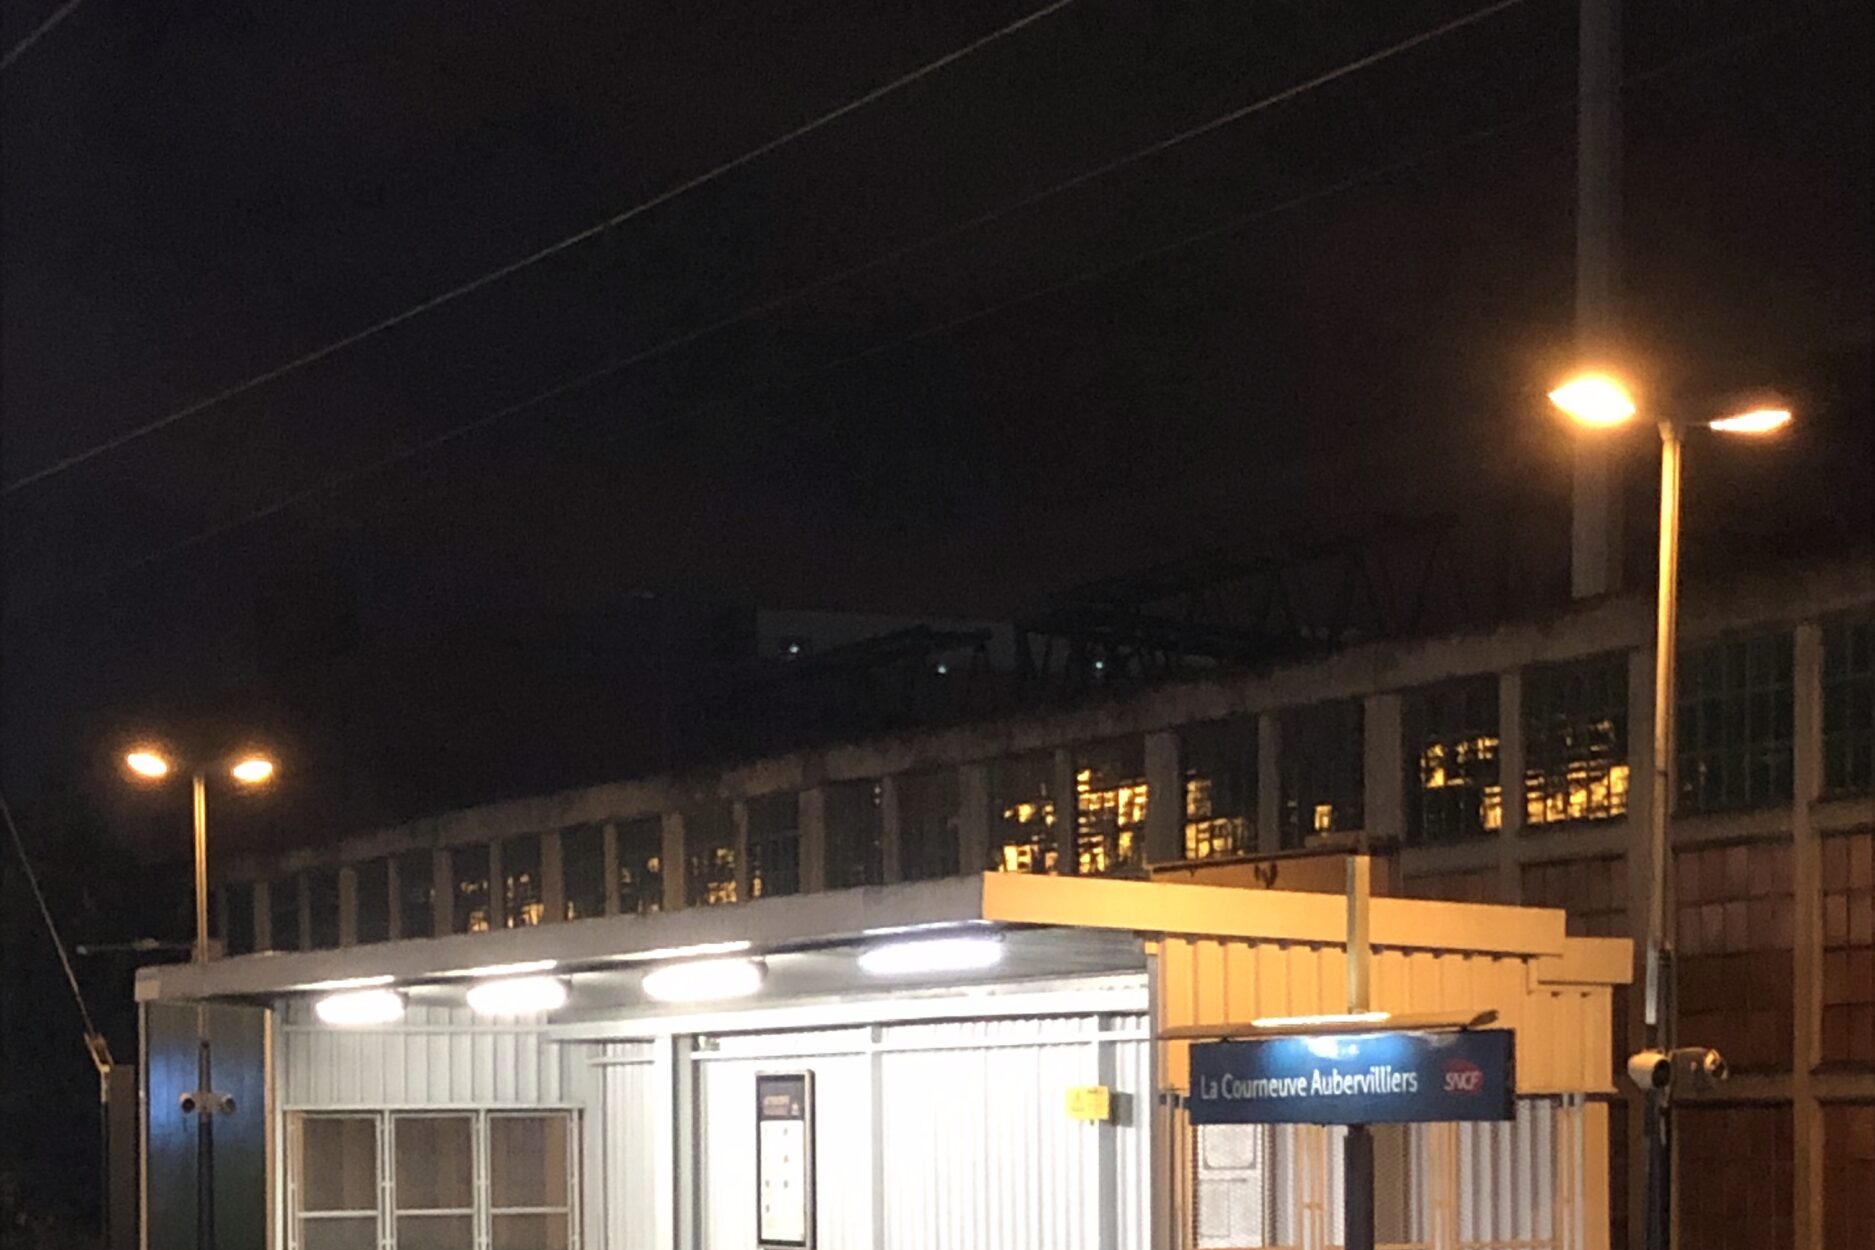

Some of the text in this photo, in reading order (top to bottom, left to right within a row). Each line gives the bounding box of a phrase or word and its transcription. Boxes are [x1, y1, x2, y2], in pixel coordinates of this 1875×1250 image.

[1200, 1065, 1418, 1099] La Courneuve Aubervilliers
[1443, 1072, 1482, 1093] SNCF
